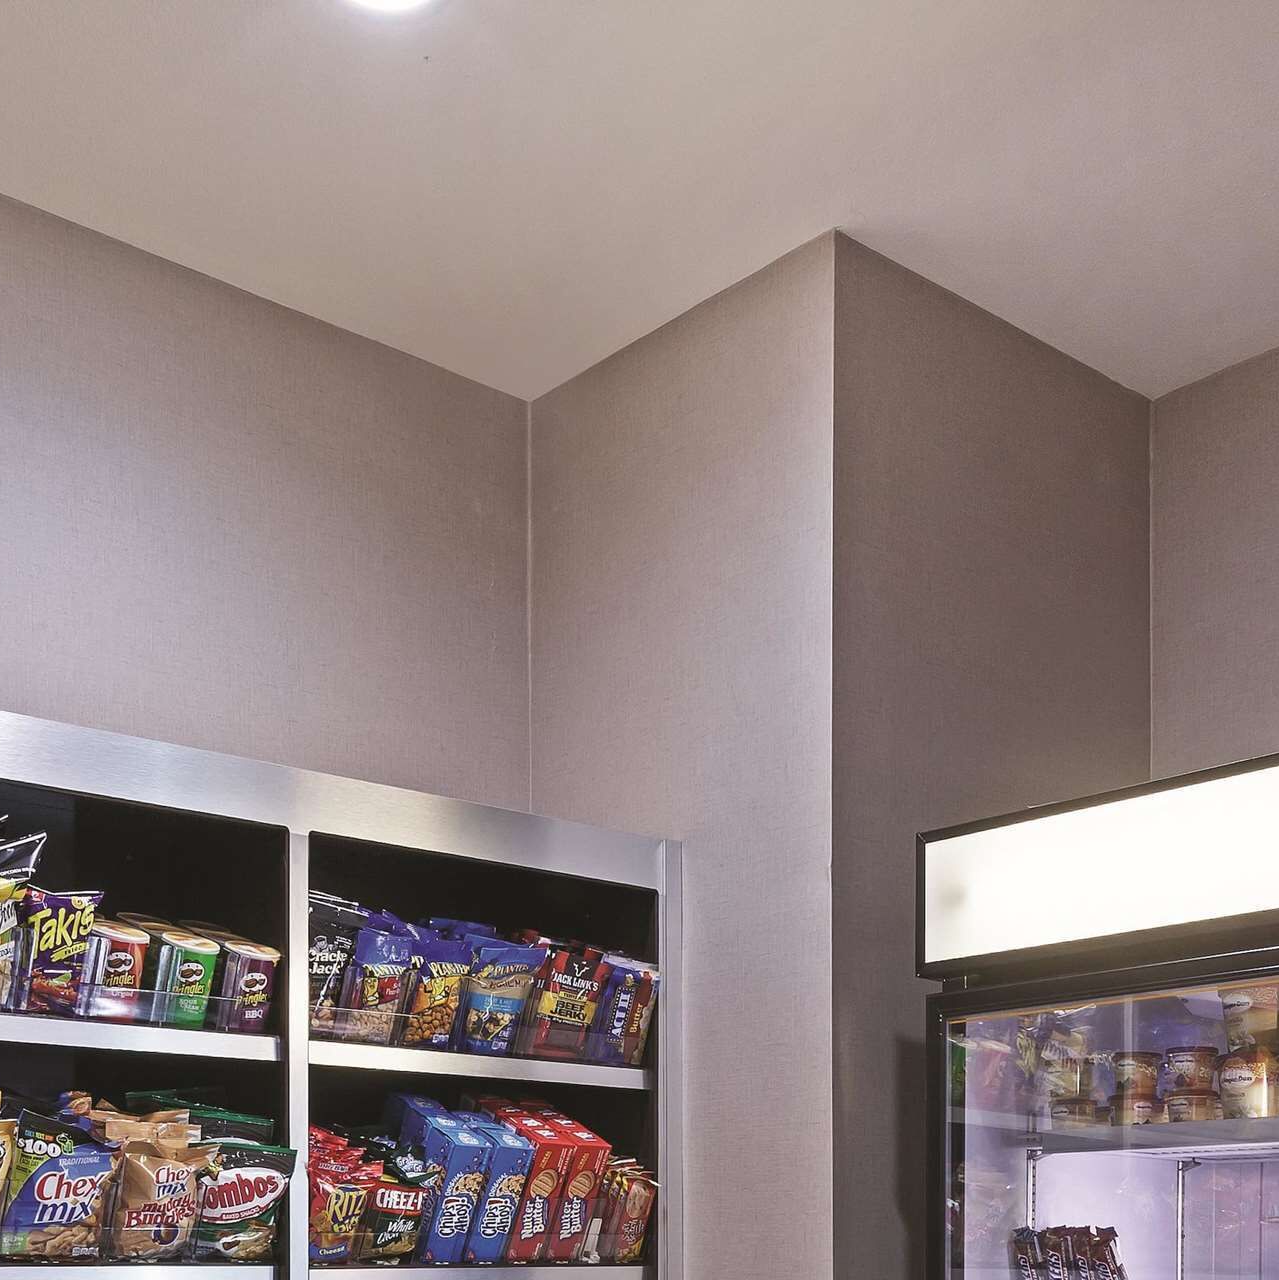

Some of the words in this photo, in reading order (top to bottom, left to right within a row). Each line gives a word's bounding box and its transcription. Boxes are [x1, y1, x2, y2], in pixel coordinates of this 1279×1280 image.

[29, 903, 96, 959] Takis
[553, 971, 572, 983] JACK
[573, 977, 600, 993] LINK'S
[549, 1007, 589, 1022] JERKY
[629, 1003, 644, 1034] Butter
[36, 1171, 104, 1202] Chex
[155, 1166, 193, 1185] Chex
[156, 1182, 188, 1198] mix
[37, 1200, 92, 1224] mix
[327, 1189, 368, 1224] RITZ
[439, 1199, 455, 1238] Chips
[481, 1199, 497, 1238] Chips
[521, 1200, 535, 1241] Nutter
[533, 1196, 546, 1234] Butter
[559, 1200, 572, 1241] Nutter
[570, 1197, 583, 1234] Butter
[388, 1220, 415, 1233] White
[319, 1246, 346, 1256] Cheese
